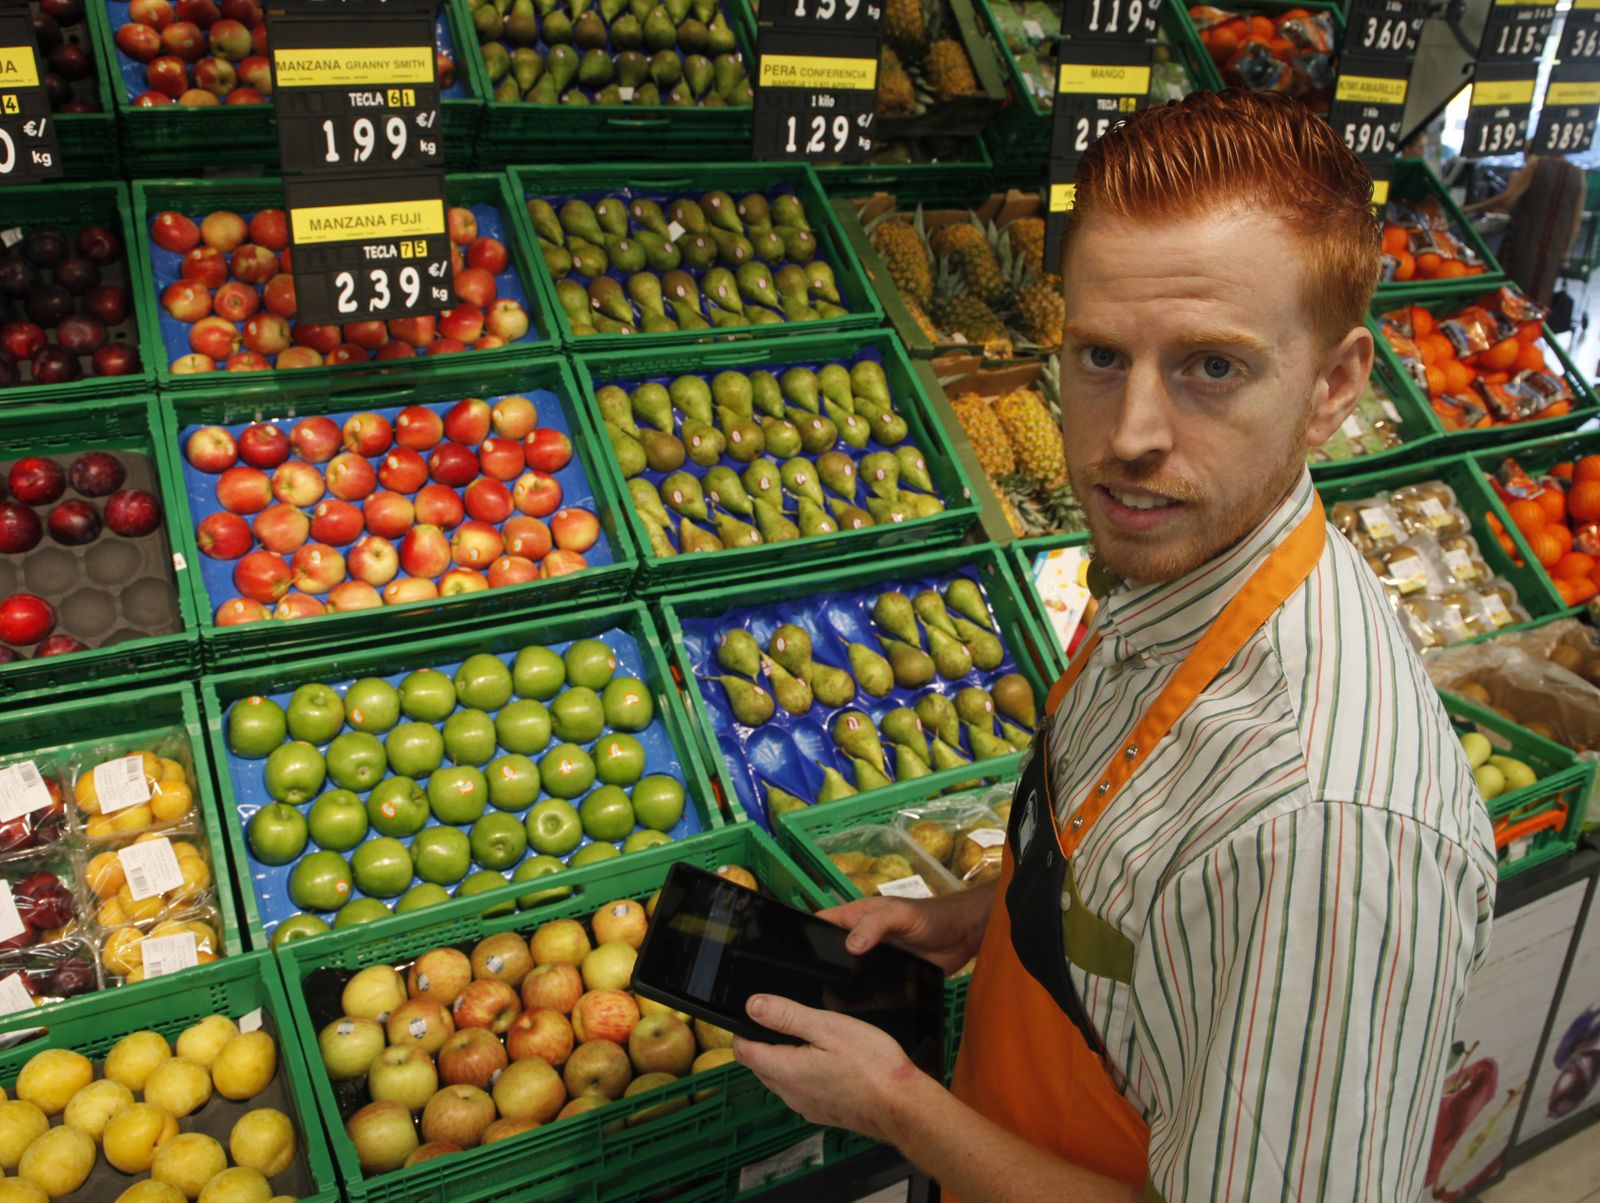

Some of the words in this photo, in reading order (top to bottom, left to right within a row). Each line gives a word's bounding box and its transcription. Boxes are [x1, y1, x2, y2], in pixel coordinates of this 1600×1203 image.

[867, 4, 881, 20] kg
[276, 60, 341, 72] MANZANA
[345, 60, 390, 70] GRANNY
[393, 59, 425, 68] SMITH
[763, 64, 797, 76] PERA
[800, 67, 867, 79] CONFERENCIA
[1090, 68, 1126, 80] MANGO
[348, 91, 384, 106] TECLA
[389, 90, 414, 107] 61
[323, 117, 407, 162] 1,99
[785, 115, 849, 154] 1,29
[420, 139, 437, 155] kg
[858, 136, 871, 151] kg
[32, 150, 52, 167] kg
[309, 215, 386, 231] MANZANA
[390, 212, 421, 225] FUJI
[363, 244, 397, 259] TECLA
[401, 241, 427, 256] 75
[335, 266, 421, 313] 2,39
[432, 286, 449, 301] kg
